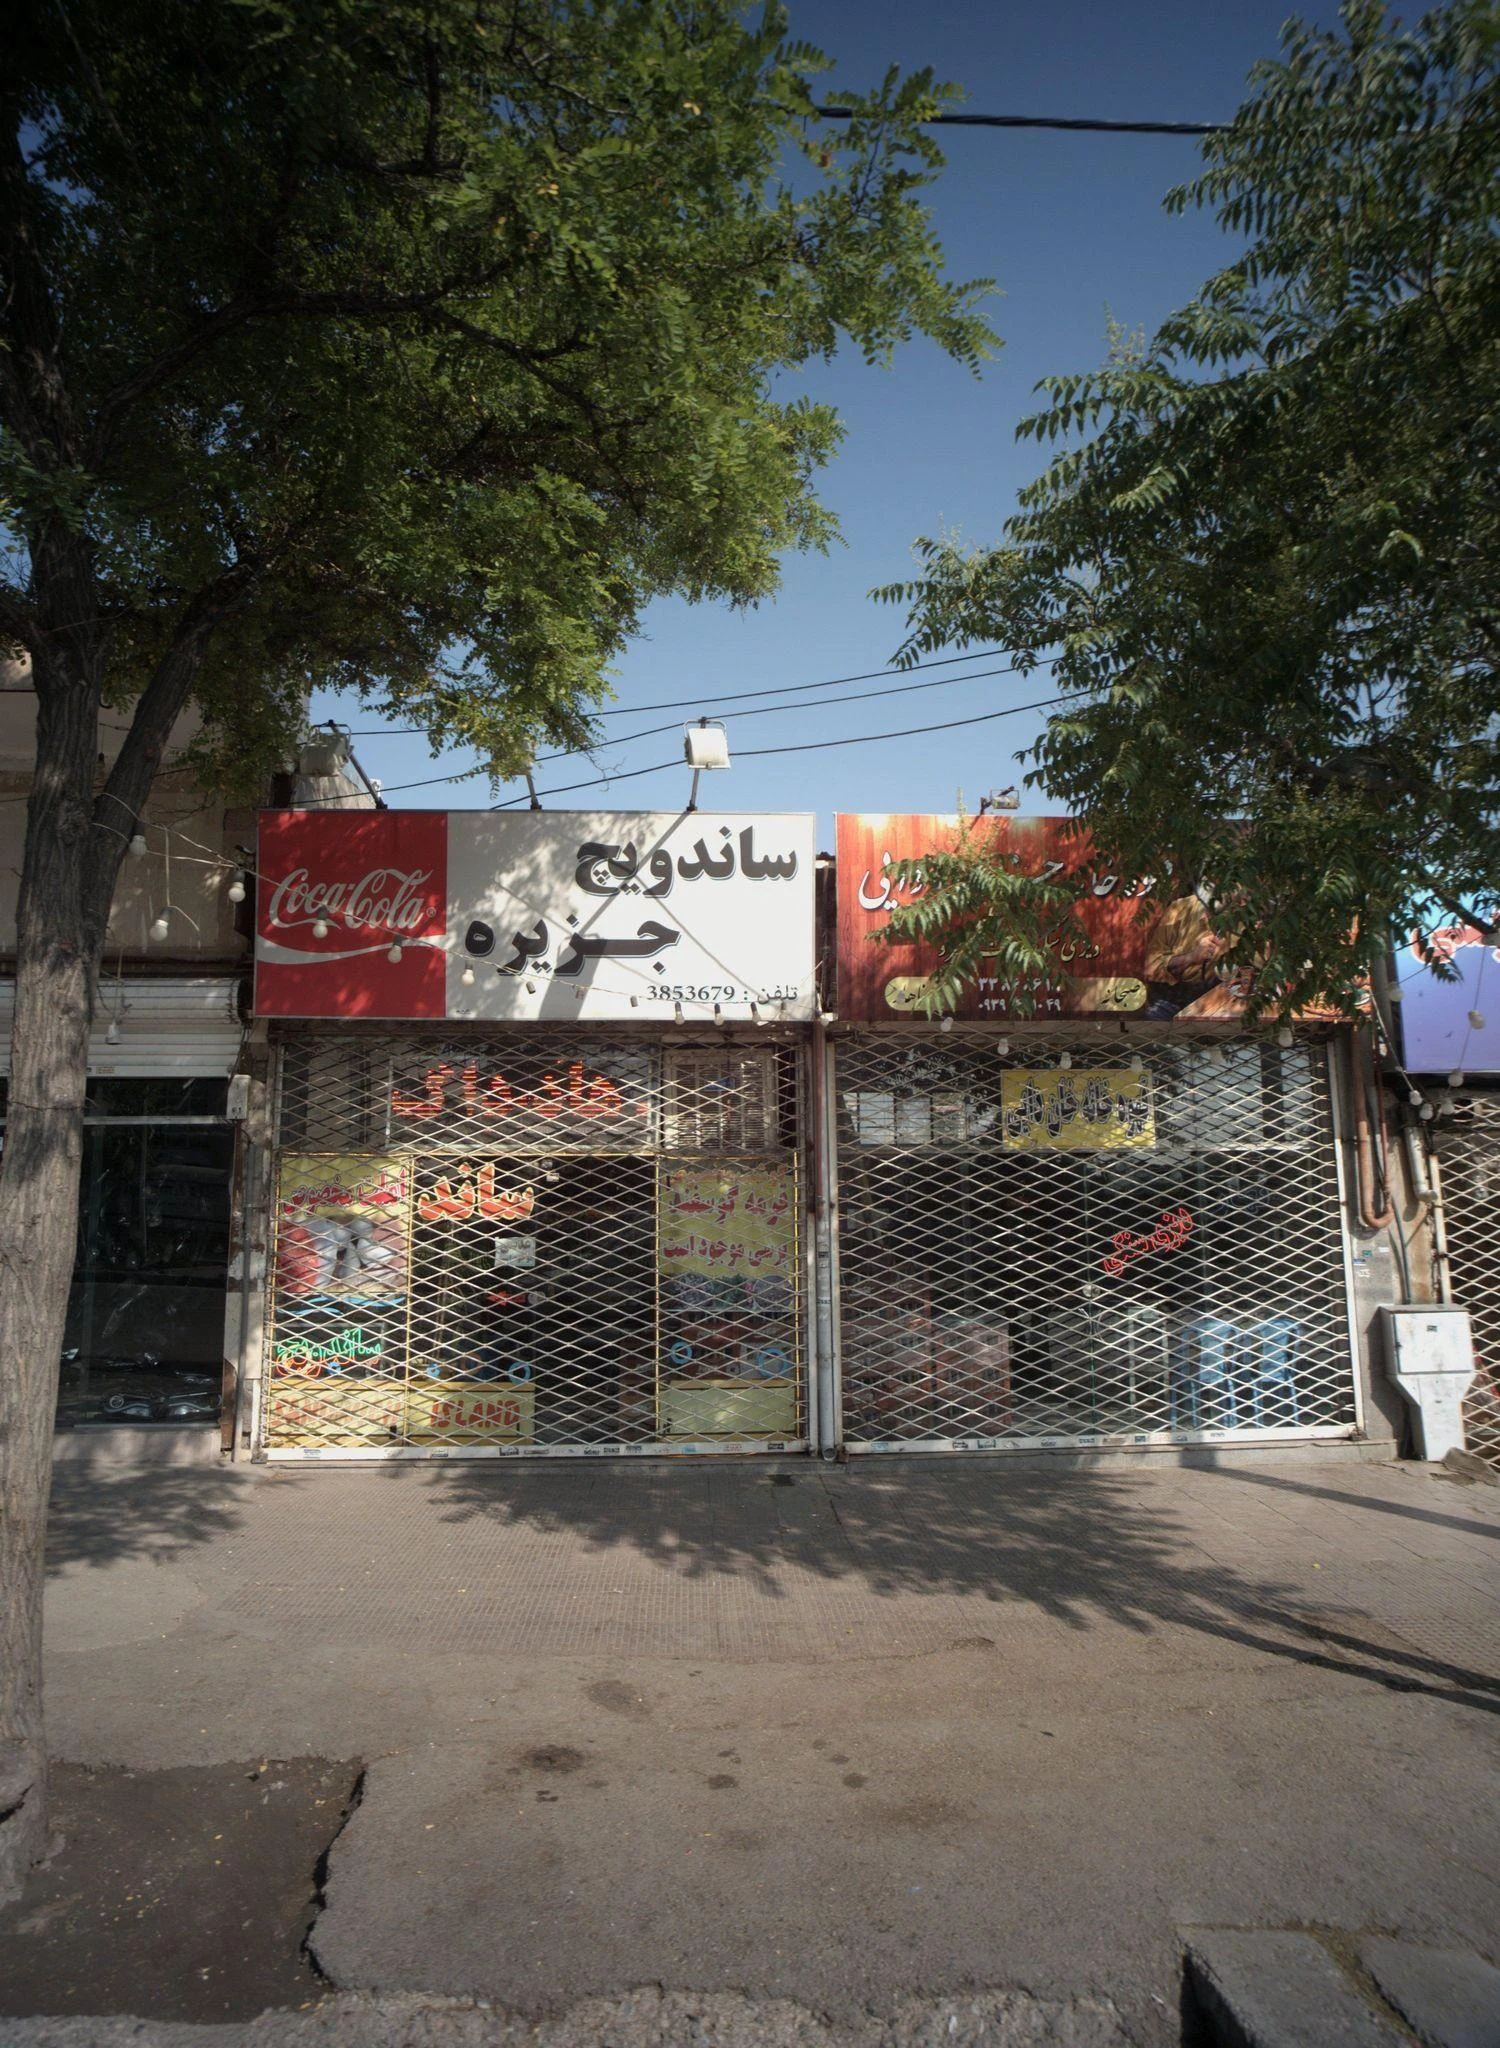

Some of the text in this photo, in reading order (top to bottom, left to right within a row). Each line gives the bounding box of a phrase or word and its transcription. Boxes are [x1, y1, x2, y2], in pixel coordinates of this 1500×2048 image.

[574, 825, 798, 898] ساندویچ
[268, 868, 433, 930] Coca-Cola
[463, 914, 682, 976] جزیره
[646, 985, 736, 1001] 3853679
[757, 984, 799, 1004] تلفن
[430, 1400, 520, 1428] ISLAND
